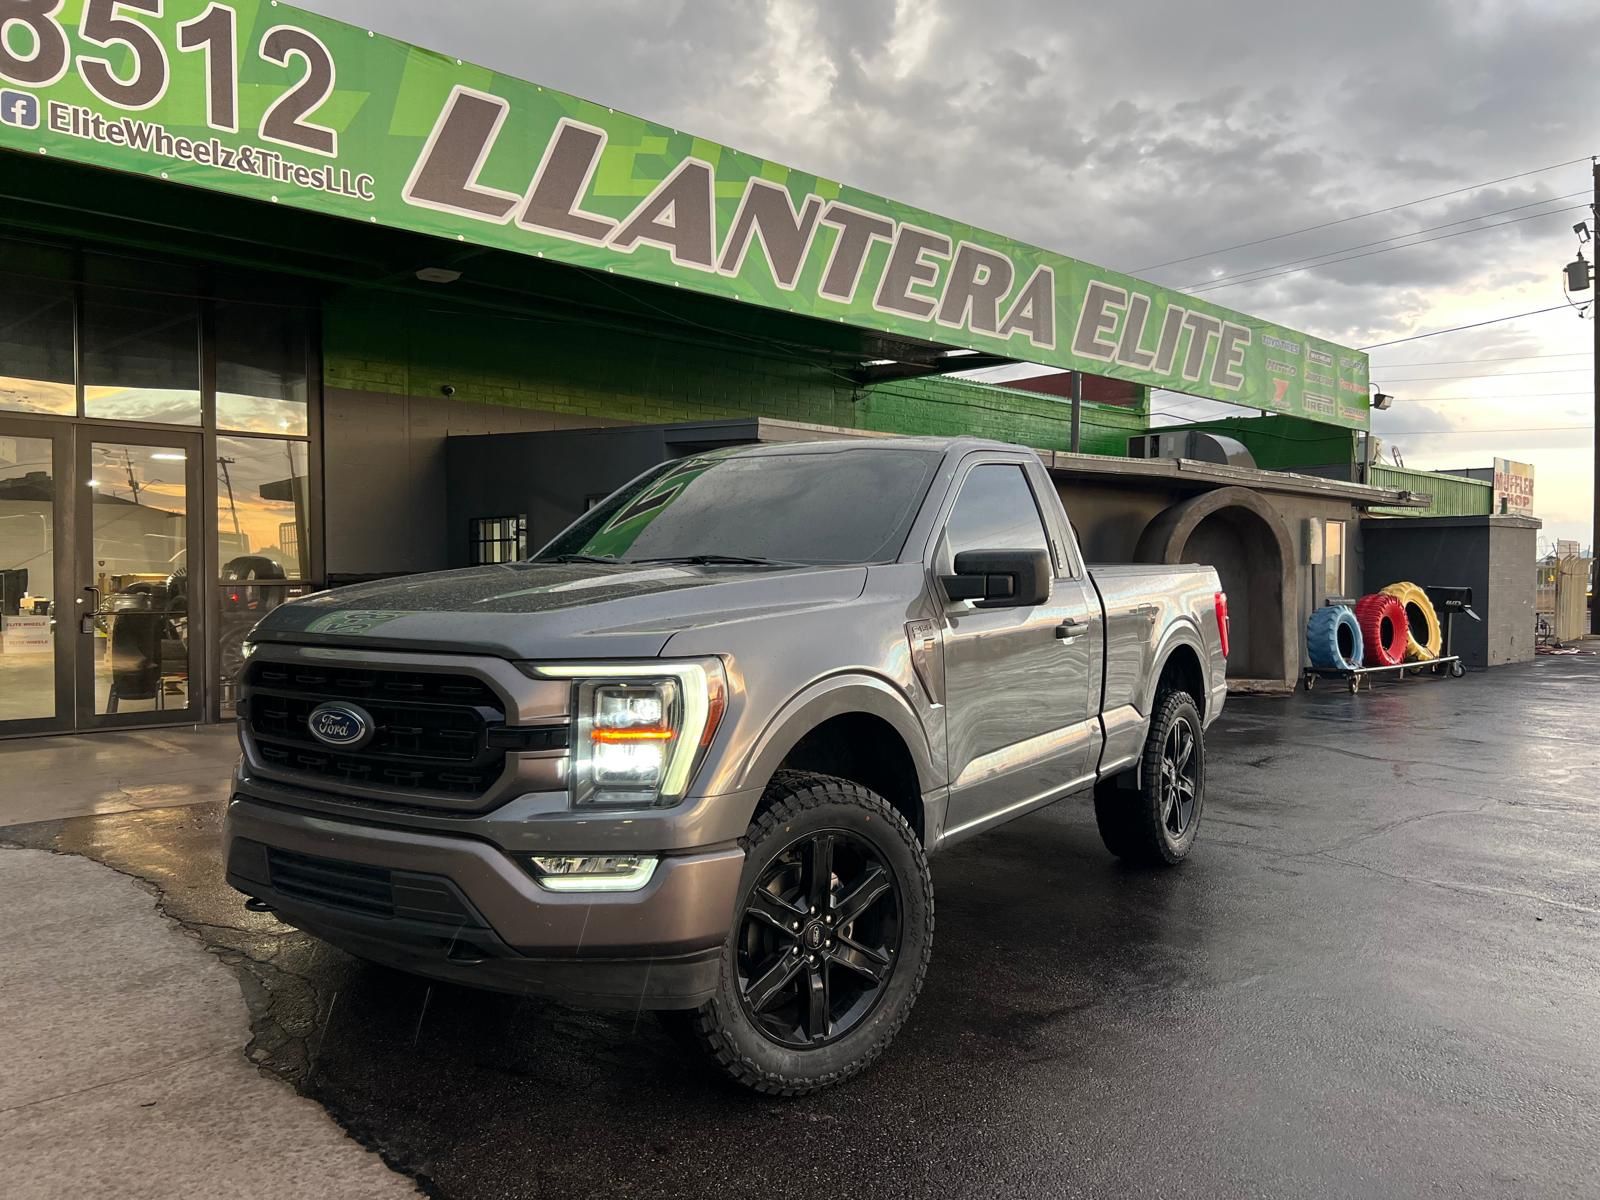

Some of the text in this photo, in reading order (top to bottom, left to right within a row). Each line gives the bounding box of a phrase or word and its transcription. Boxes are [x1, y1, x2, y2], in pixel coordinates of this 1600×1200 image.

[0, 0, 338, 157] 8512
[48, 100, 375, 200] EliteWheelz&TiresLLC
[402, 84, 1251, 391] LLANTERA ELITE
[1495, 471, 1534, 497] MUFFLER
[319, 714, 349, 736] Ford
